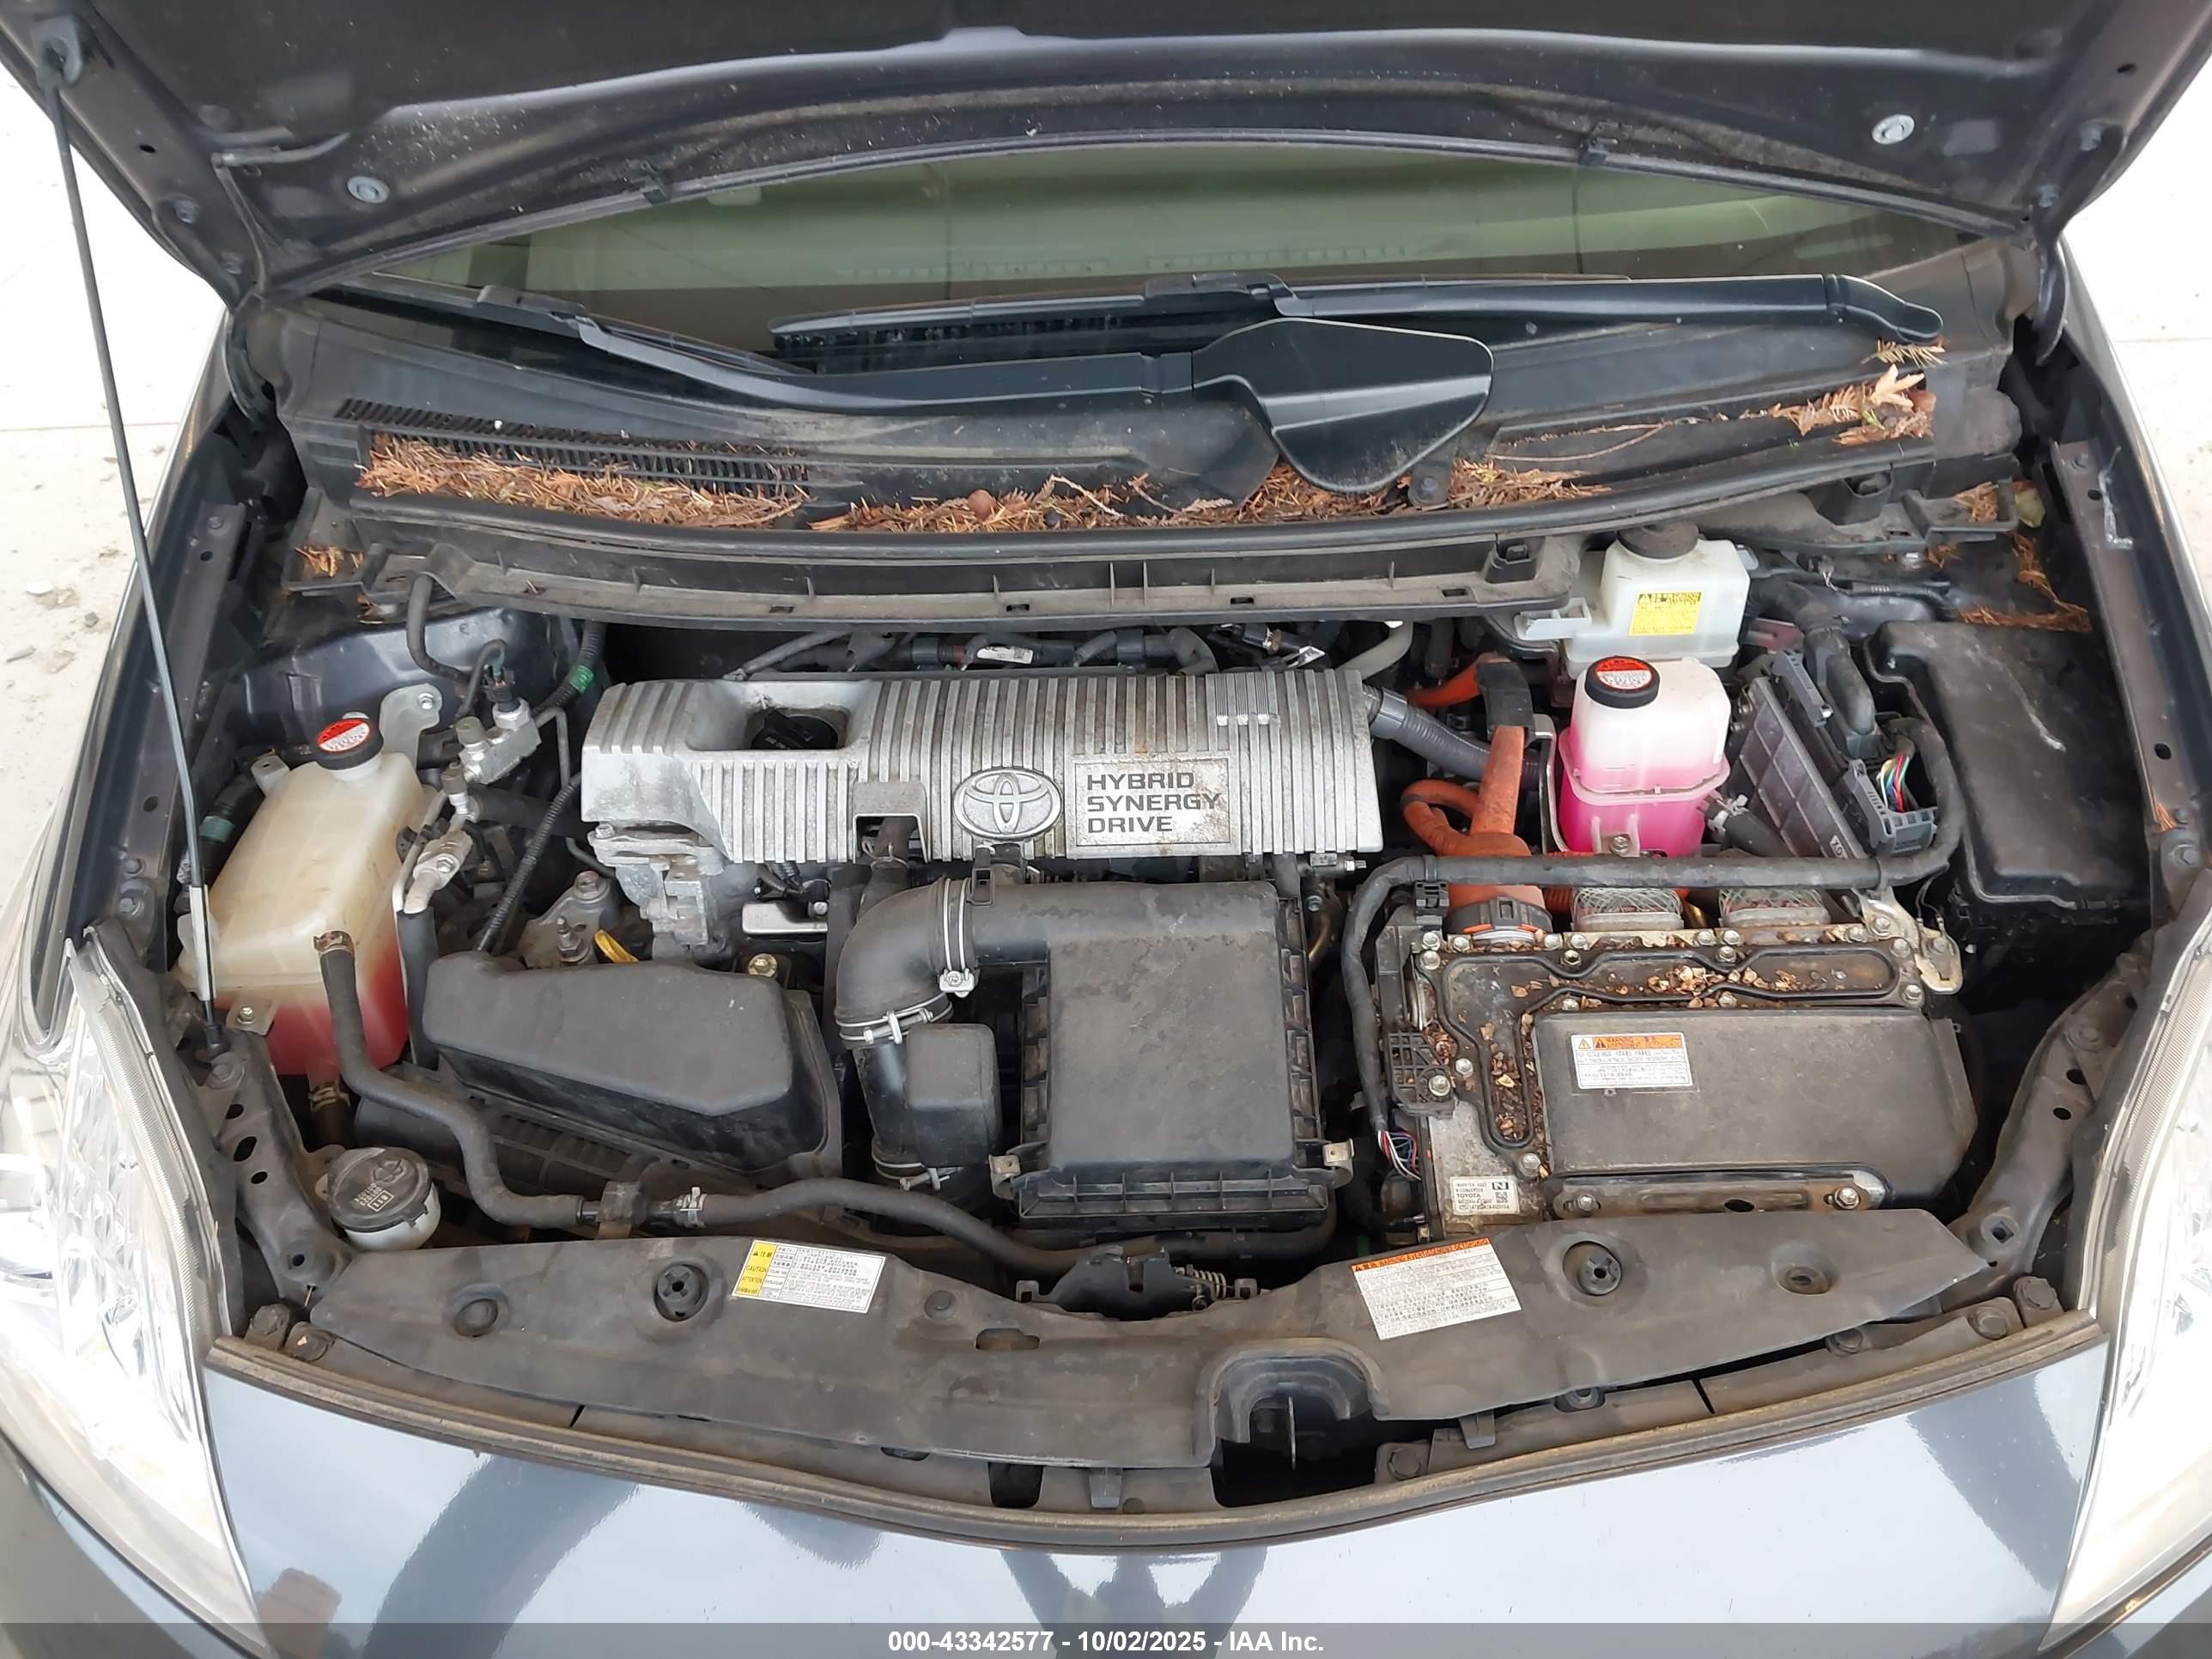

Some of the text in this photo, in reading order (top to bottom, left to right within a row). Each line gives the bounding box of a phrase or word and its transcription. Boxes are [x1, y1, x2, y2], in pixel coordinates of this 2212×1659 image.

[1087, 772, 1194, 790] HYBRID
[1087, 793, 1222, 812] SYNERGY
[1088, 816, 1173, 833] DRIVE
